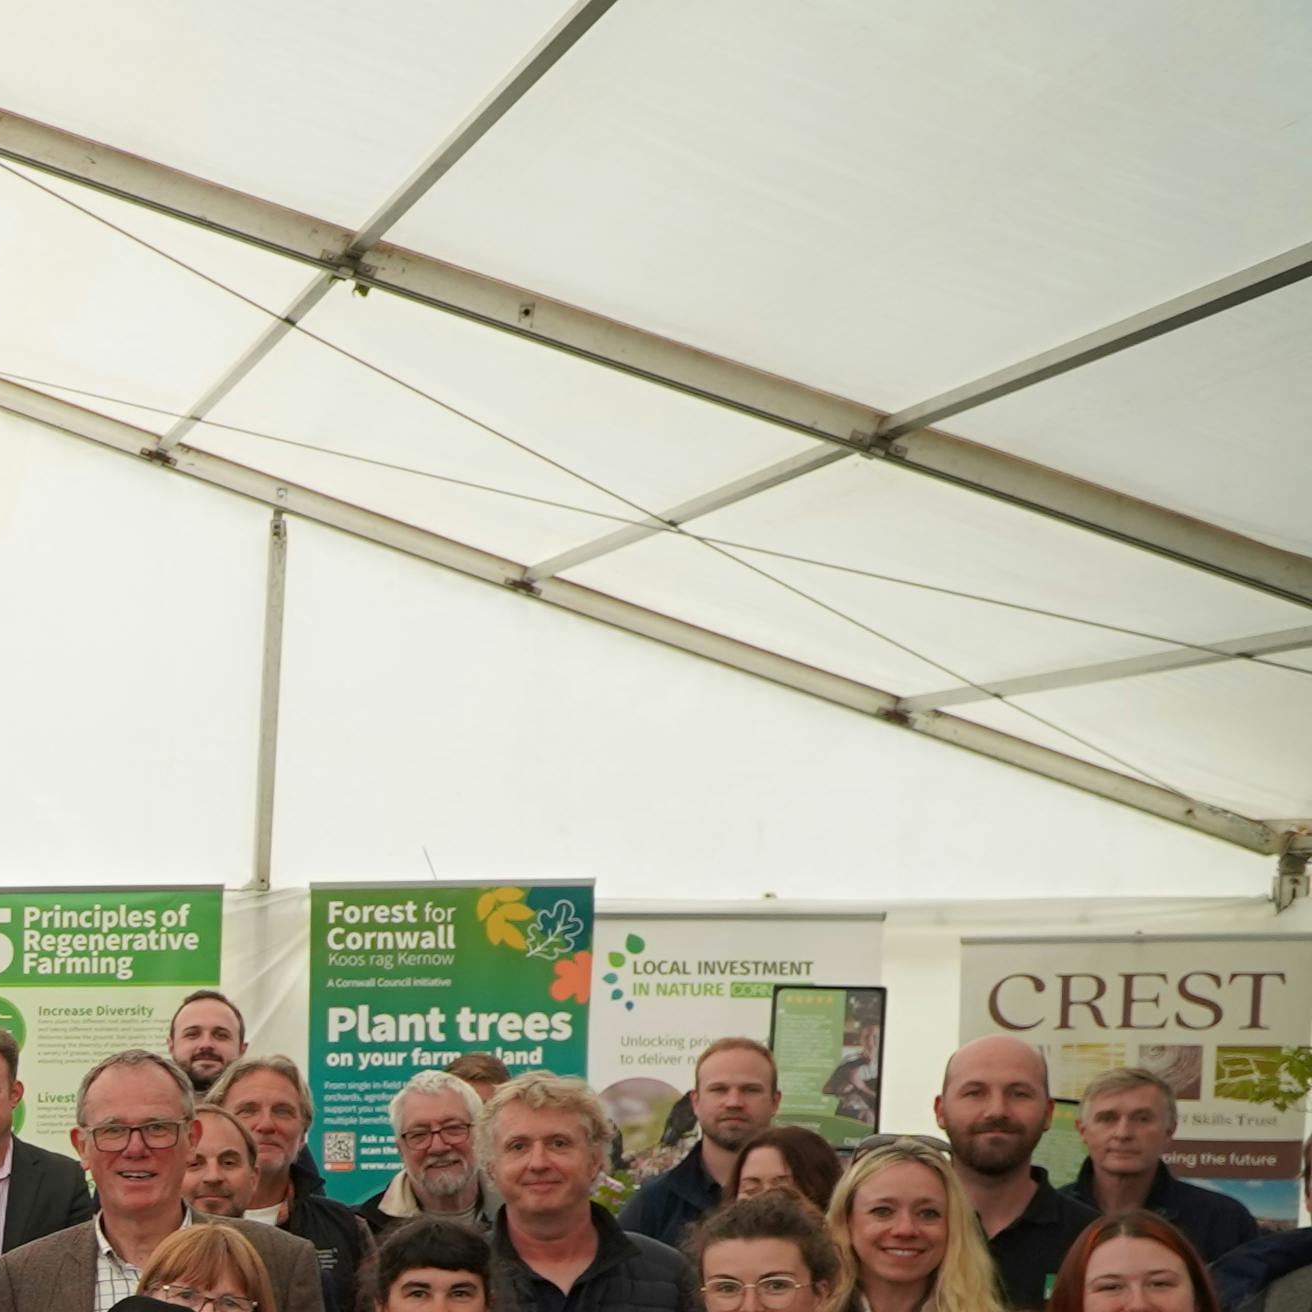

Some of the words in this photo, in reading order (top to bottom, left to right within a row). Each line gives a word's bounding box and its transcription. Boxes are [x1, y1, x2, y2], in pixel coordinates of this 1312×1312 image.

[23, 904, 156, 933] Principles
[161, 903, 192, 927] of
[327, 900, 417, 924] Forest
[424, 901, 456, 923] for
[23, 927, 199, 957] Regenerative
[326, 924, 456, 951] Cornwall
[23, 951, 134, 980] Farming
[328, 952, 365, 966] Koos
[369, 954, 394, 970] rag
[398, 952, 455, 966] Kernow
[633, 960, 691, 976] LOCAL
[697, 960, 815, 976] INVESTMENT
[327, 978, 335, 988] A
[632, 982, 650, 997] IN
[656, 982, 724, 997] NATURE
[988, 971, 1287, 1031] CREST
[38, 1006, 93, 1016] Increase
[97, 1005, 154, 1018] Diversity
[327, 1005, 446, 1043] Plant
[456, 1006, 573, 1042] trees
[620, 1035, 685, 1050] Unlocking
[326, 1050, 353, 1066] on
[358, 1050, 409, 1070] your
[620, 1054, 634, 1064] to
[638, 1053, 681, 1064] deliver
[38, 1092, 76, 1103] Livest
[1199, 1152, 1226, 1165] the
[1229, 1152, 1277, 1166] future
